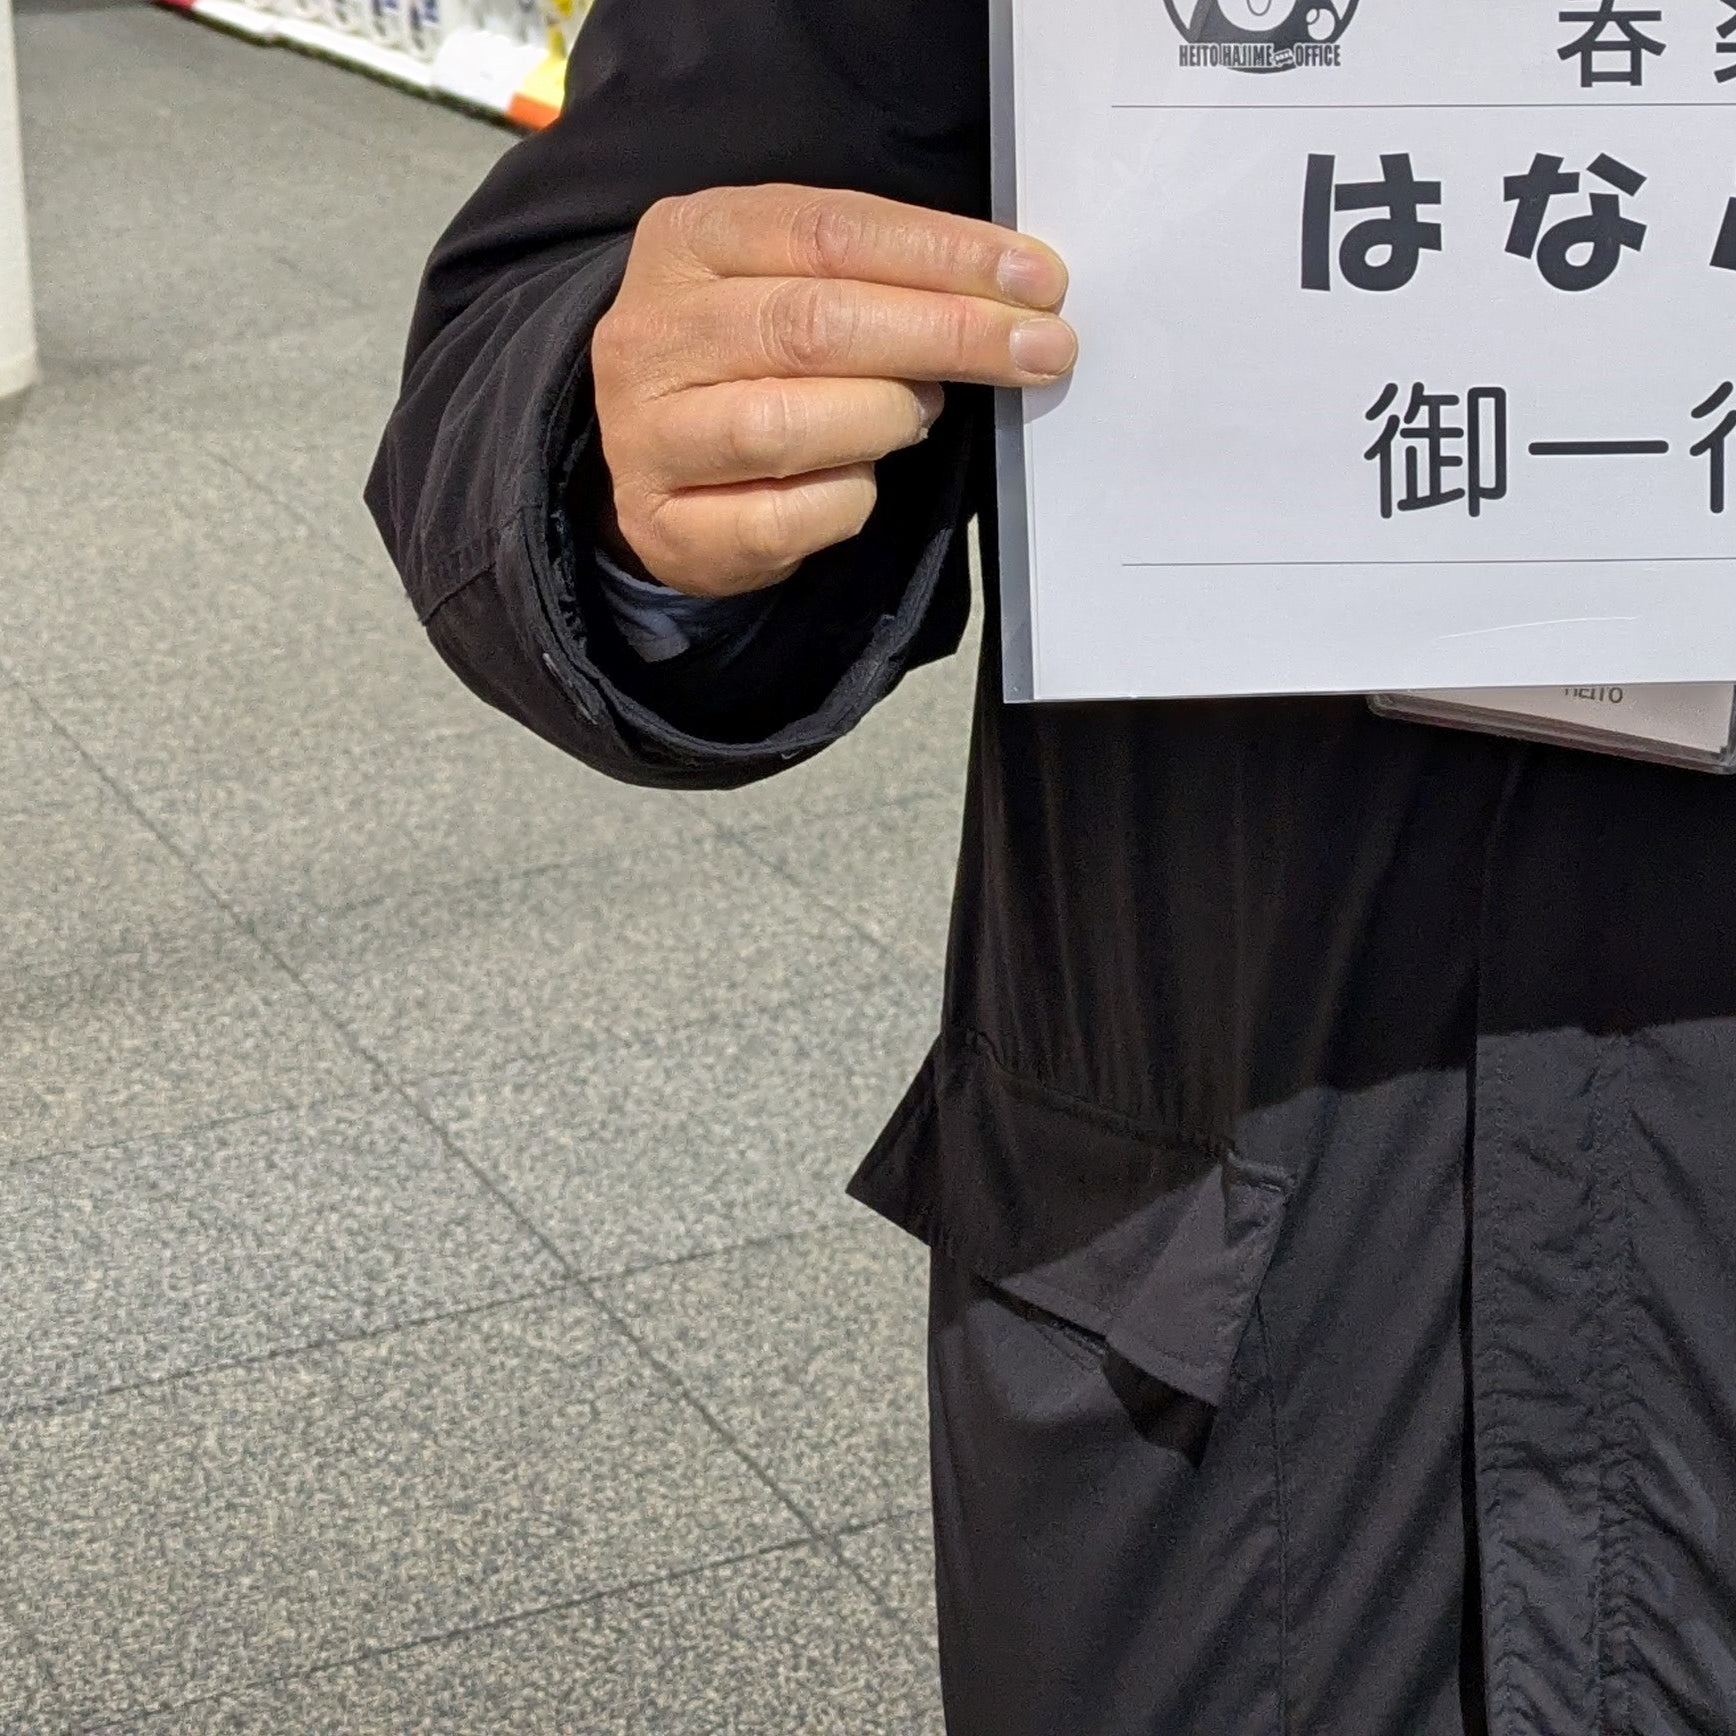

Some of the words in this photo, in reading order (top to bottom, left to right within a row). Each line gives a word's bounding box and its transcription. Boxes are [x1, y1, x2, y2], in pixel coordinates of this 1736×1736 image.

[1179, 44, 1219, 67] HEITO
[1222, 44, 1272, 67] HAJIME
[1294, 44, 1341, 67] OFFICE
